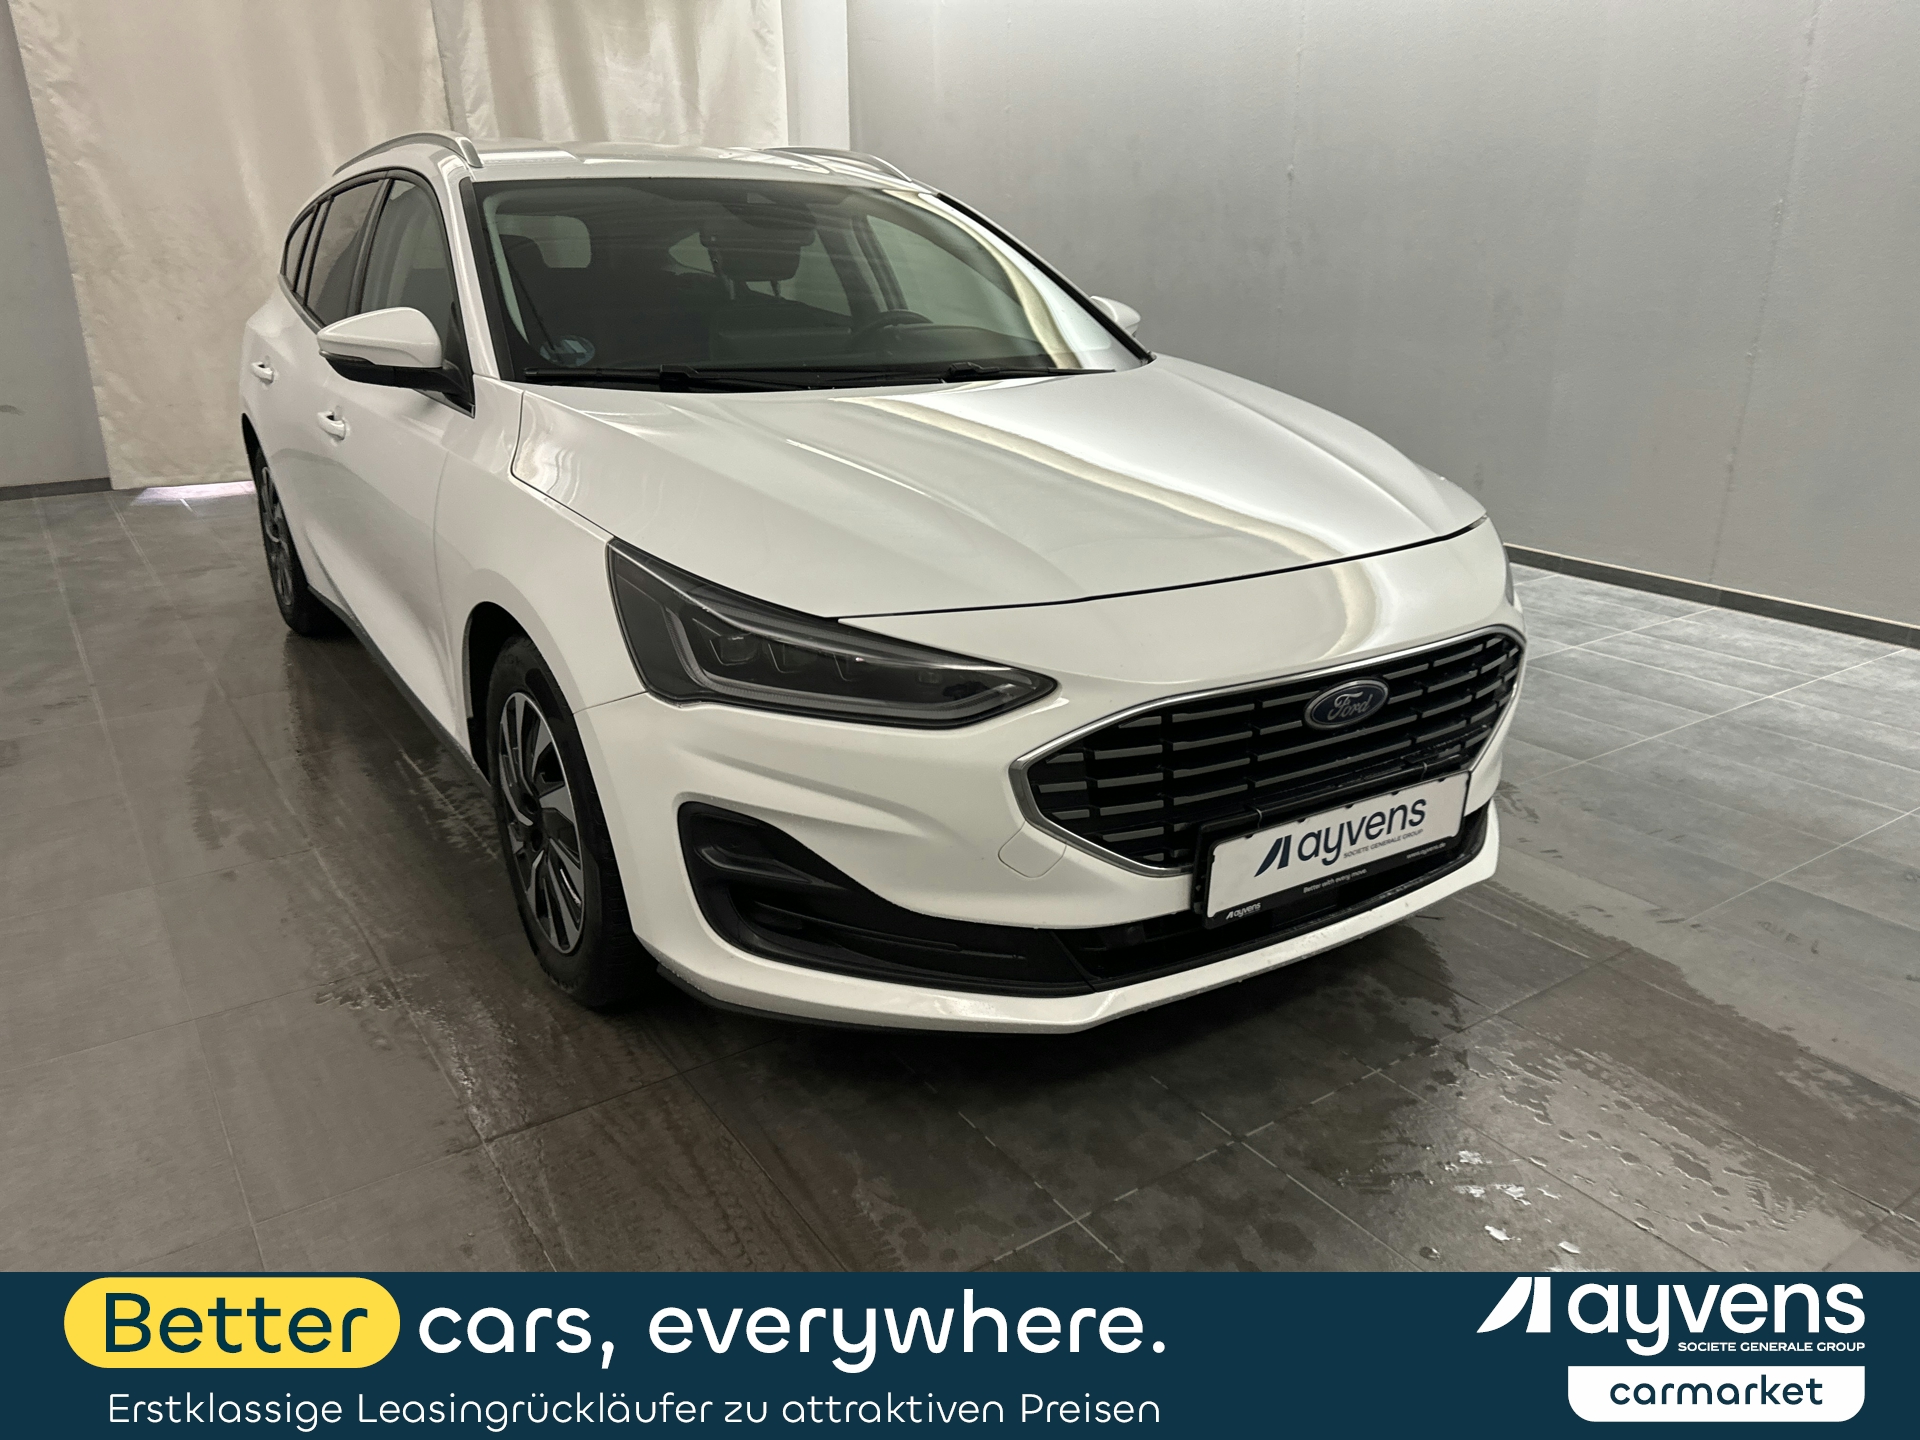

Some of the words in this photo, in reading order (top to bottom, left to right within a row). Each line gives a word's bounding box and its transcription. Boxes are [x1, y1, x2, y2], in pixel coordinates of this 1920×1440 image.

[1327, 691, 1373, 721] Ford
[1297, 799, 1427, 866] ayvens
[1343, 845, 1370, 858] SOCIETE
[1370, 835, 1401, 850] GENERALE
[1402, 828, 1424, 840] GROUP
[1233, 902, 1261, 918] ayvens
